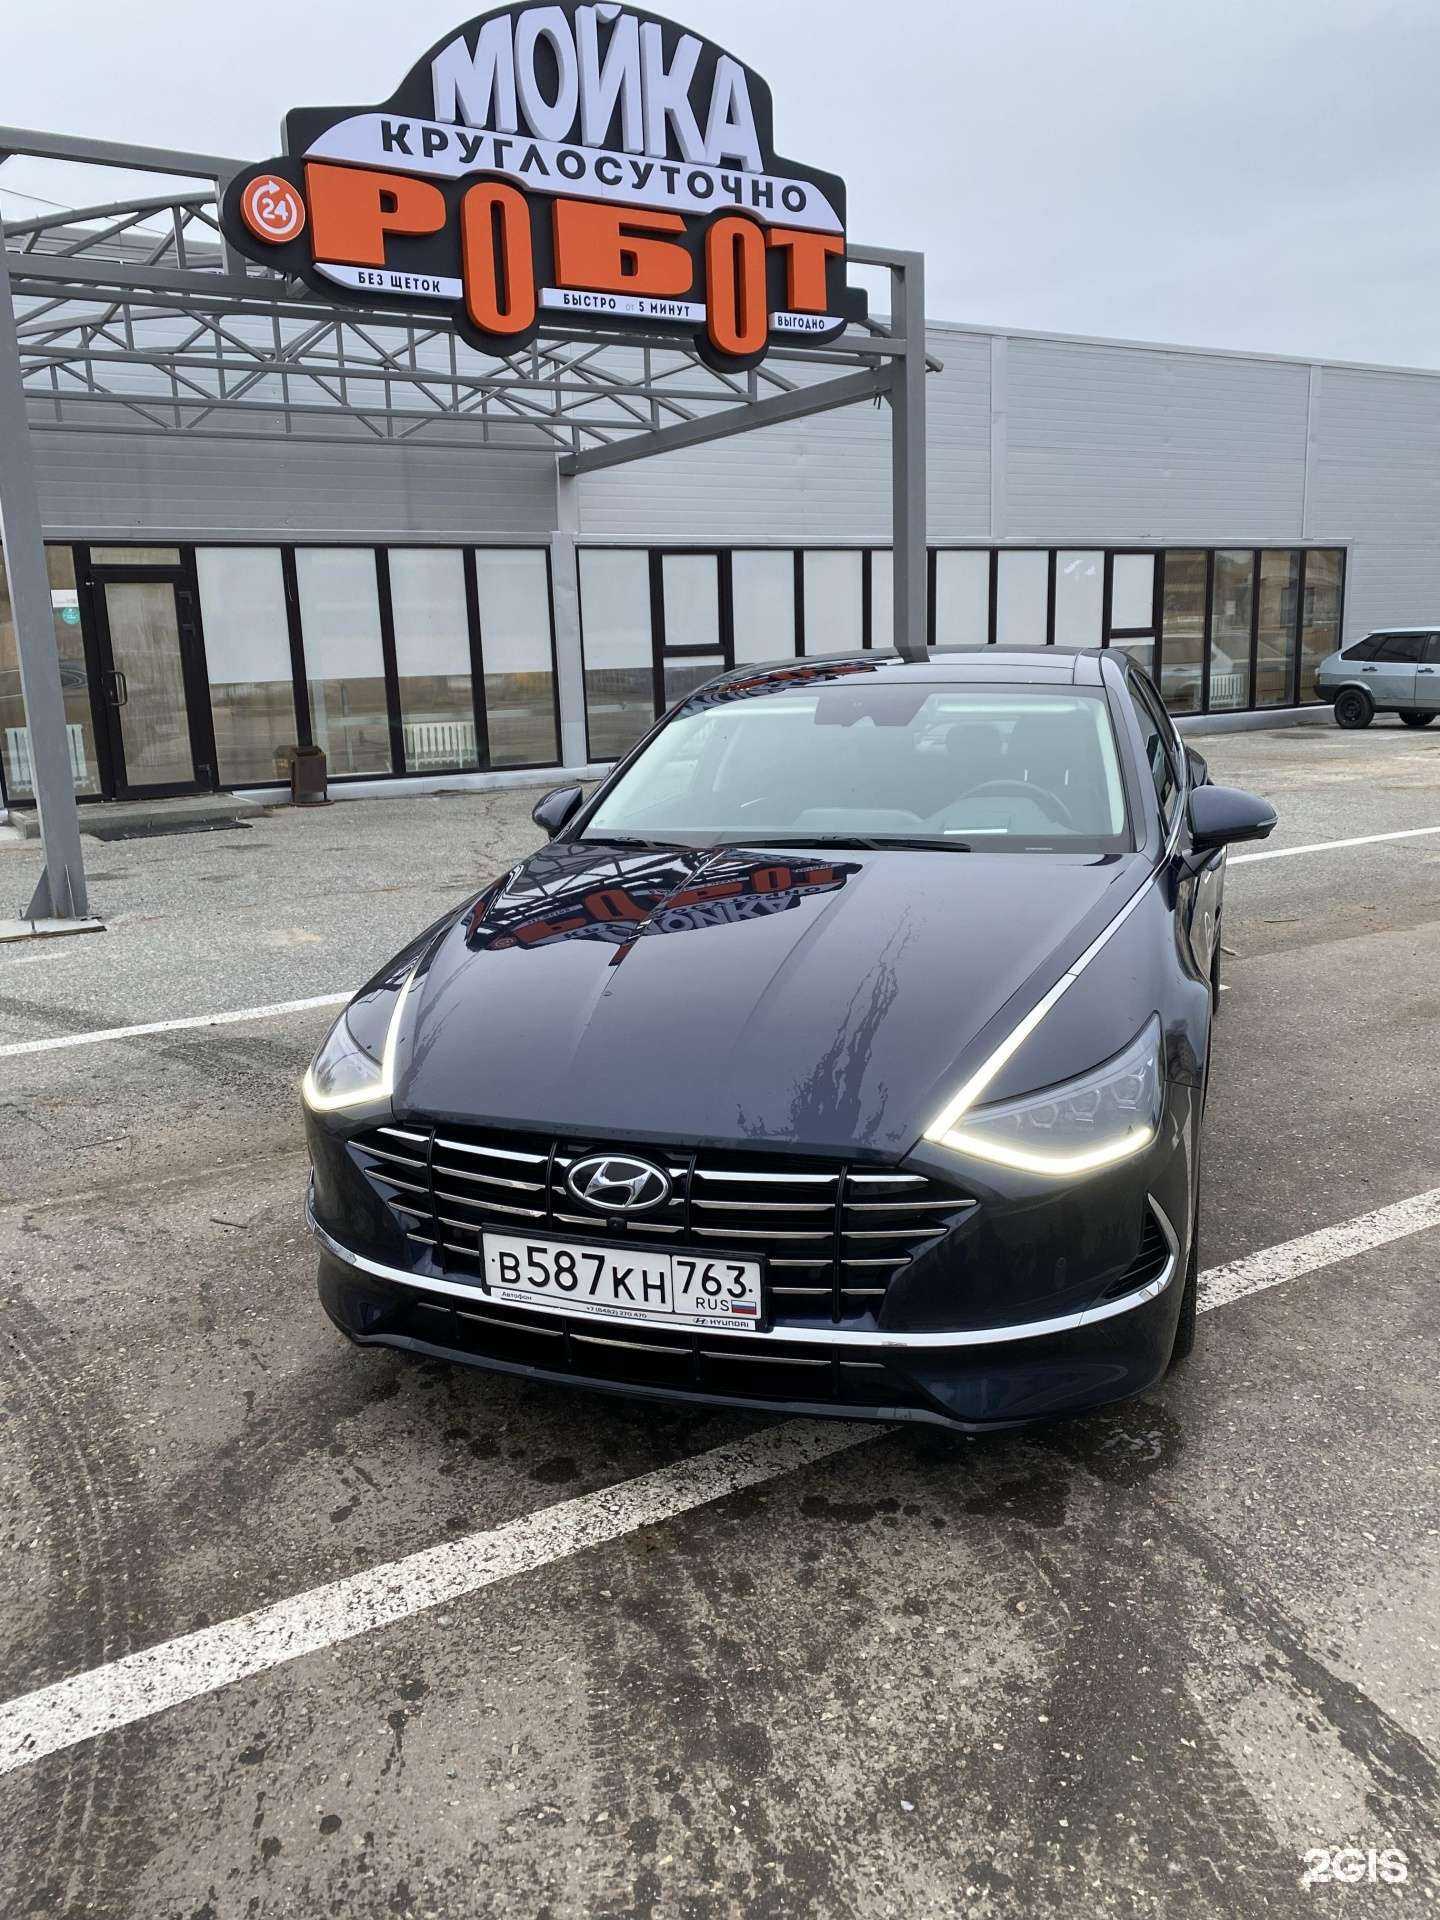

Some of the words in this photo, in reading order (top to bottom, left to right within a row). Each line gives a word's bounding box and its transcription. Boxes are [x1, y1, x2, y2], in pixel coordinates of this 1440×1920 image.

[431, 3, 765, 174] МОЙКА
[381, 120, 807, 213] КРУГЛОСУТОЧНО
[261, 197, 288, 221] 24
[304, 162, 845, 355] РОБОТ
[358, 271, 383, 286] БЕЗ
[390, 275, 440, 293] ЩЕТОК
[563, 293, 617, 310] БЫСТРО
[639, 301, 645, 313] 5
[650, 302, 690, 317] МИНУТ
[777, 315, 825, 330] ВЫГОДНО
[677, 1260, 747, 1298] 763
[695, 1296, 730, 1312] RUS
[709, 1319, 749, 1328] HYUNDAI
